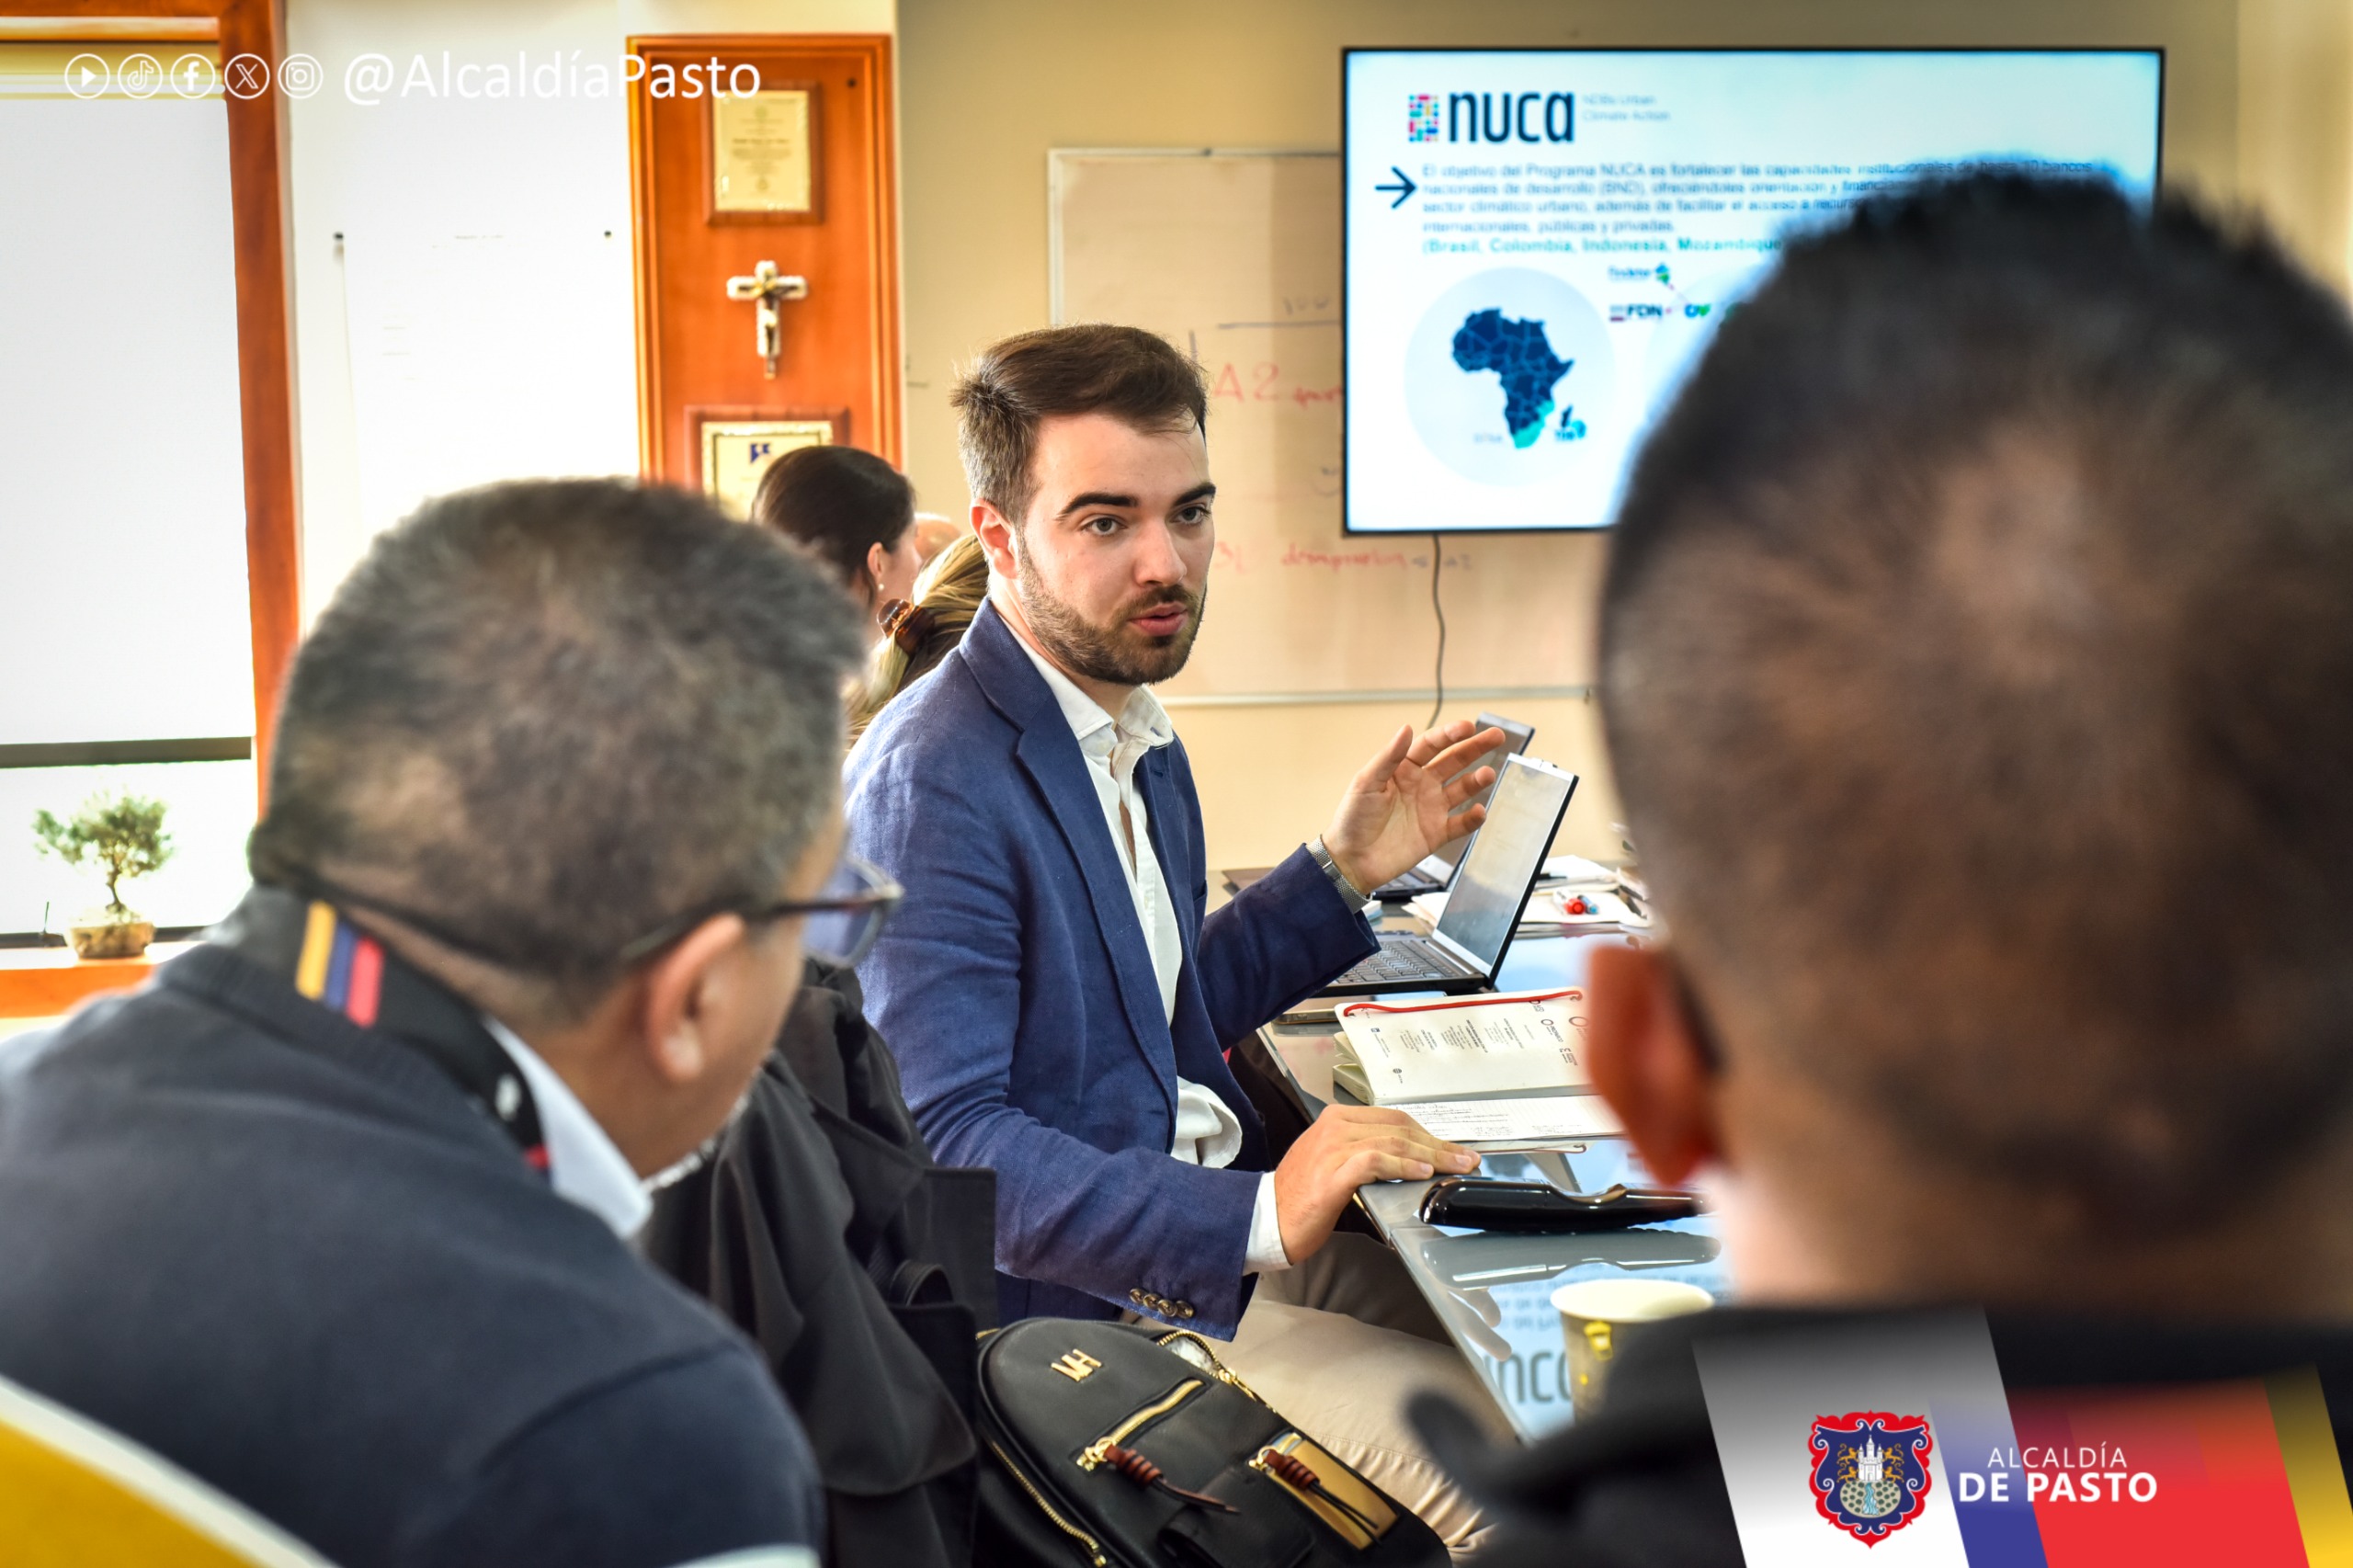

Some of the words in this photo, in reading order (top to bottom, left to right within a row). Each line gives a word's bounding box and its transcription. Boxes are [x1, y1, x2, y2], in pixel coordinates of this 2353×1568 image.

[1448, 92, 1574, 142] nuca
[1422, 164, 1437, 177] El
[1440, 164, 1497, 181] objetivo
[1500, 164, 1522, 177] del
[1526, 163, 1597, 179] Programa
[1599, 163, 1646, 176] NUCA
[1650, 165, 1666, 176] es
[1671, 164, 1735, 176] fortalecer
[1741, 164, 1760, 176] las
[1766, 164, 1851, 180] capacidades
[1858, 162, 1953, 176] institucionales
[1957, 160, 1973, 173] de
[1980, 160, 2018, 173] hasta
[2042, 160, 2093, 173] bancos
[1423, 183, 1499, 196] nacionales
[1504, 183, 1521, 196] de
[1526, 182, 1596, 196] desarrollo
[1423, 201, 1465, 214] sector
[1656, 200, 1672, 213] de
[1677, 199, 1726, 212] facilitar
[1732, 199, 1744, 212] el
[1749, 200, 1797, 211] acceso
[1488, 237, 1578, 255] Colombia,
[1582, 237, 1671, 255] Indonesia,
